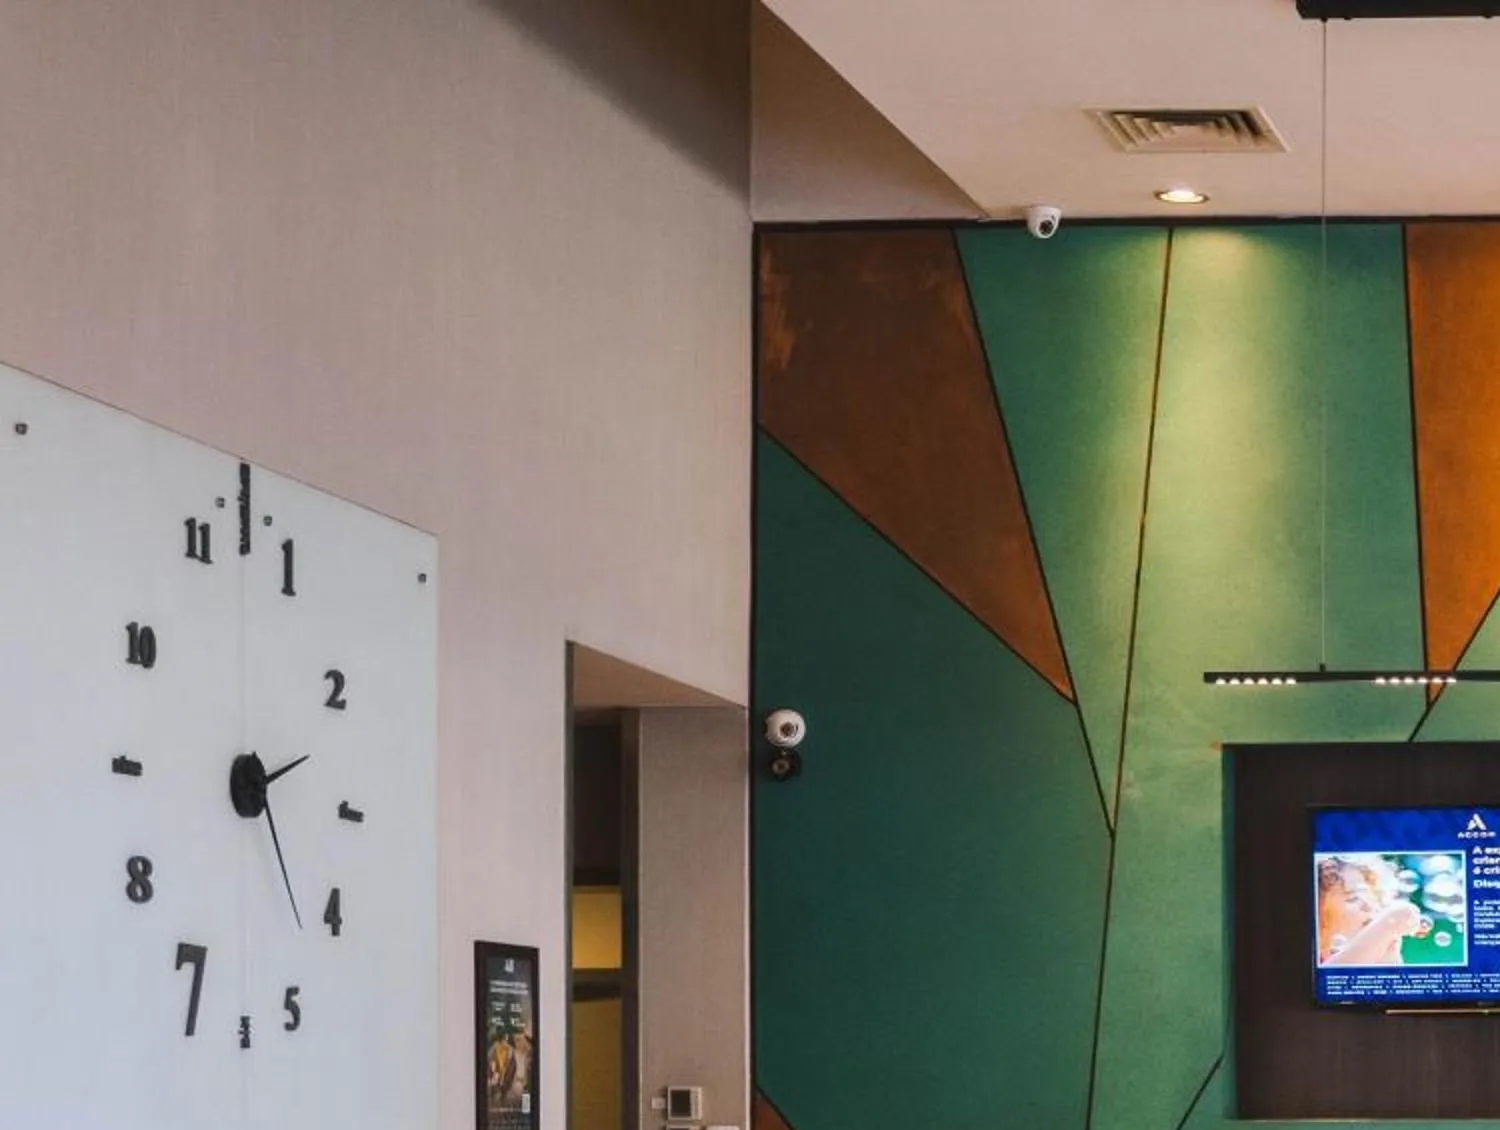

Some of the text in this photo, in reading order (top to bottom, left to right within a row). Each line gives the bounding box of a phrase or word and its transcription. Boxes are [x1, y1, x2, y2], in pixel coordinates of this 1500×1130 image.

[184, 517, 213, 565] 11
[281, 539, 296, 597] 1
[125, 621, 157, 669] 10
[324, 669, 347, 710] 2
[1472, 846, 1482, 855] A
[125, 855, 153, 904] 8
[323, 887, 343, 937] 4
[175, 942, 208, 1037] 7
[283, 986, 301, 1032] 5
